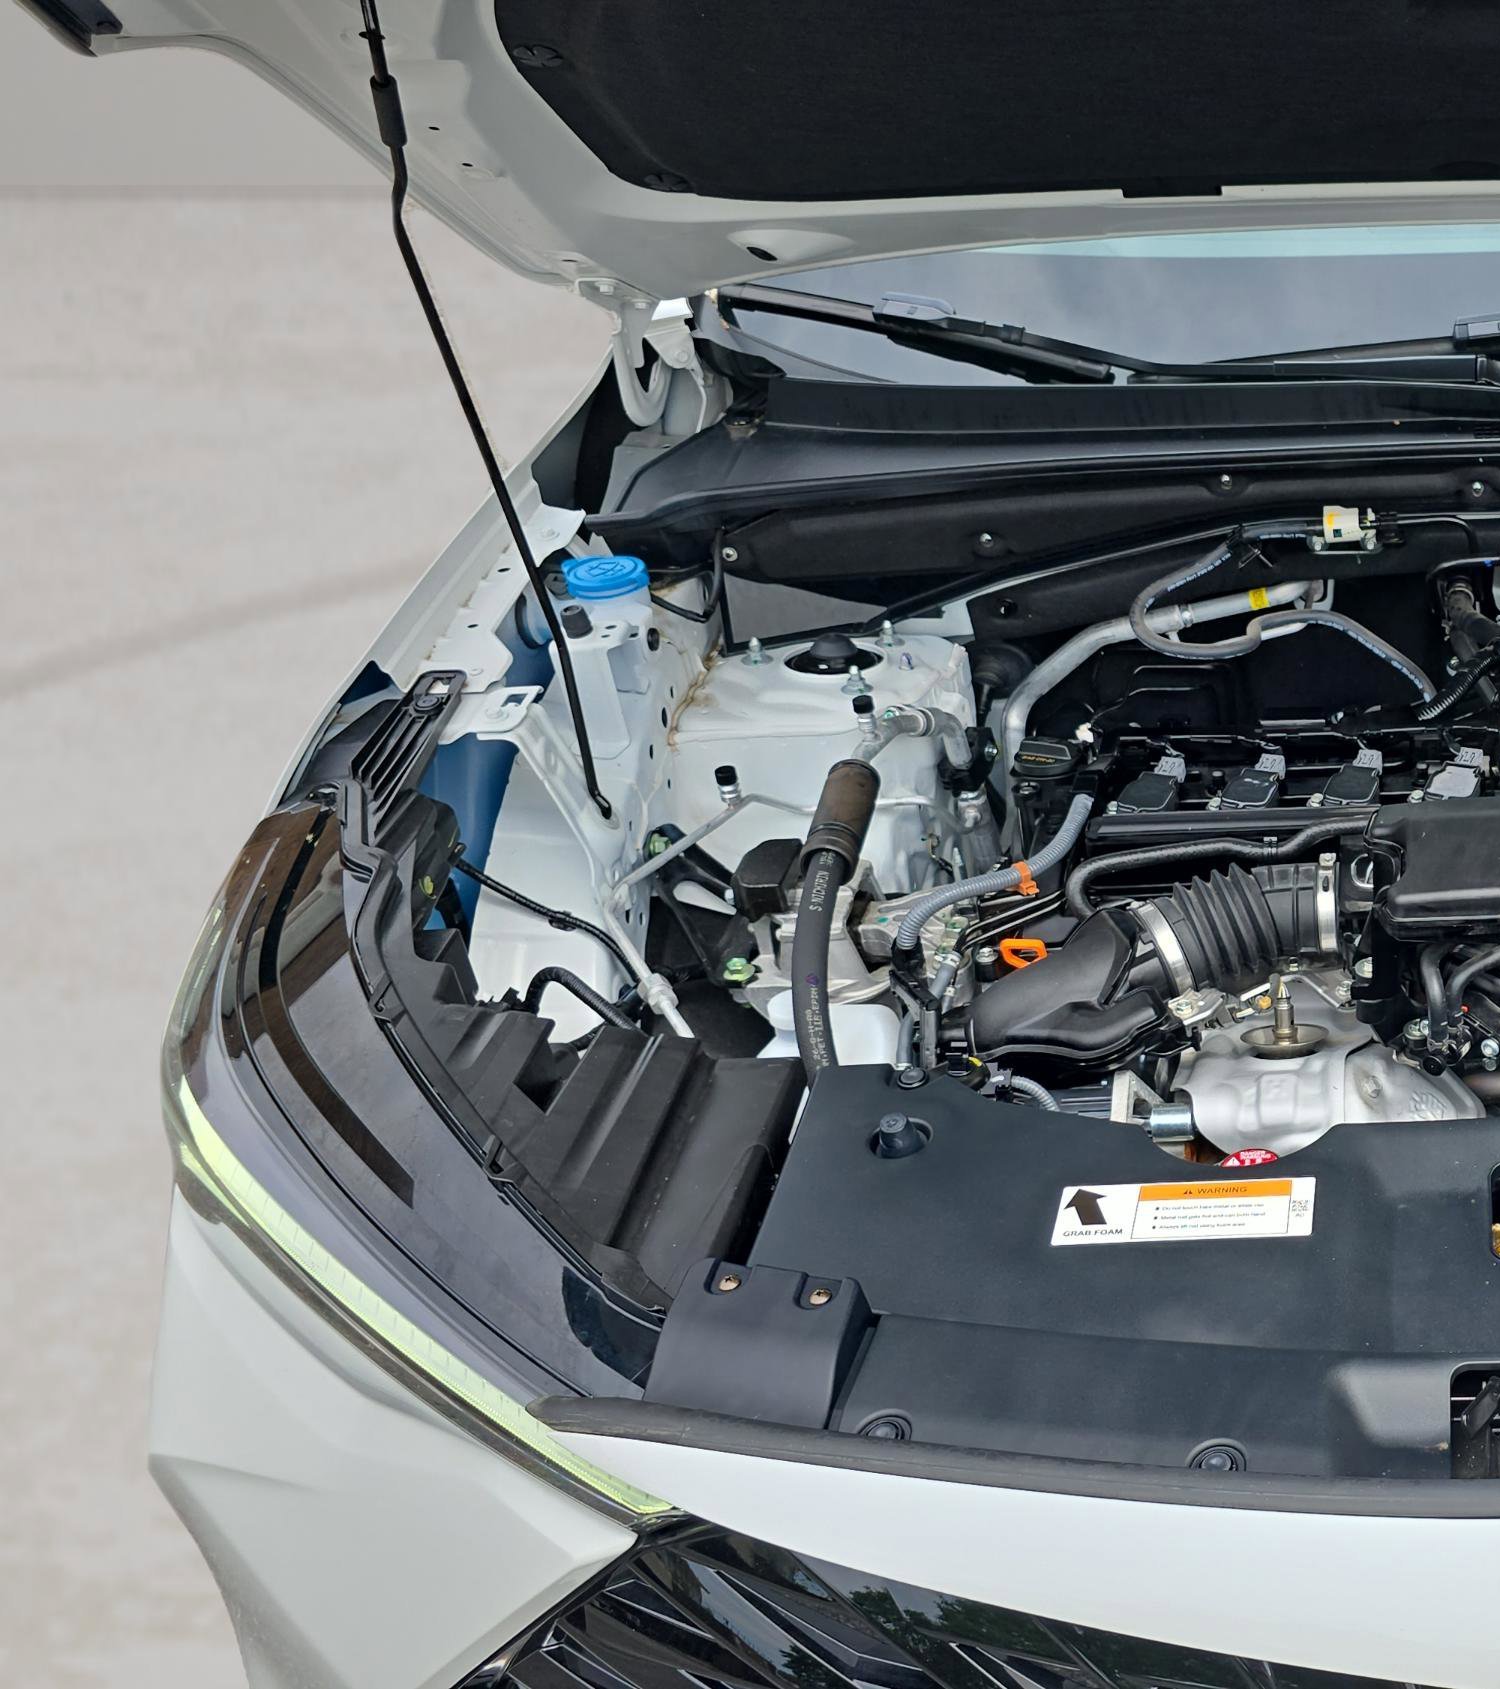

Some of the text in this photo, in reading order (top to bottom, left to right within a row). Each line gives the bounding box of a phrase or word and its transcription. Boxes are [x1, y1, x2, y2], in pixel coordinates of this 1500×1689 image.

[1197, 1186, 1248, 1194] WARNING
[1062, 1228, 1123, 1238] GRAB FOAM
